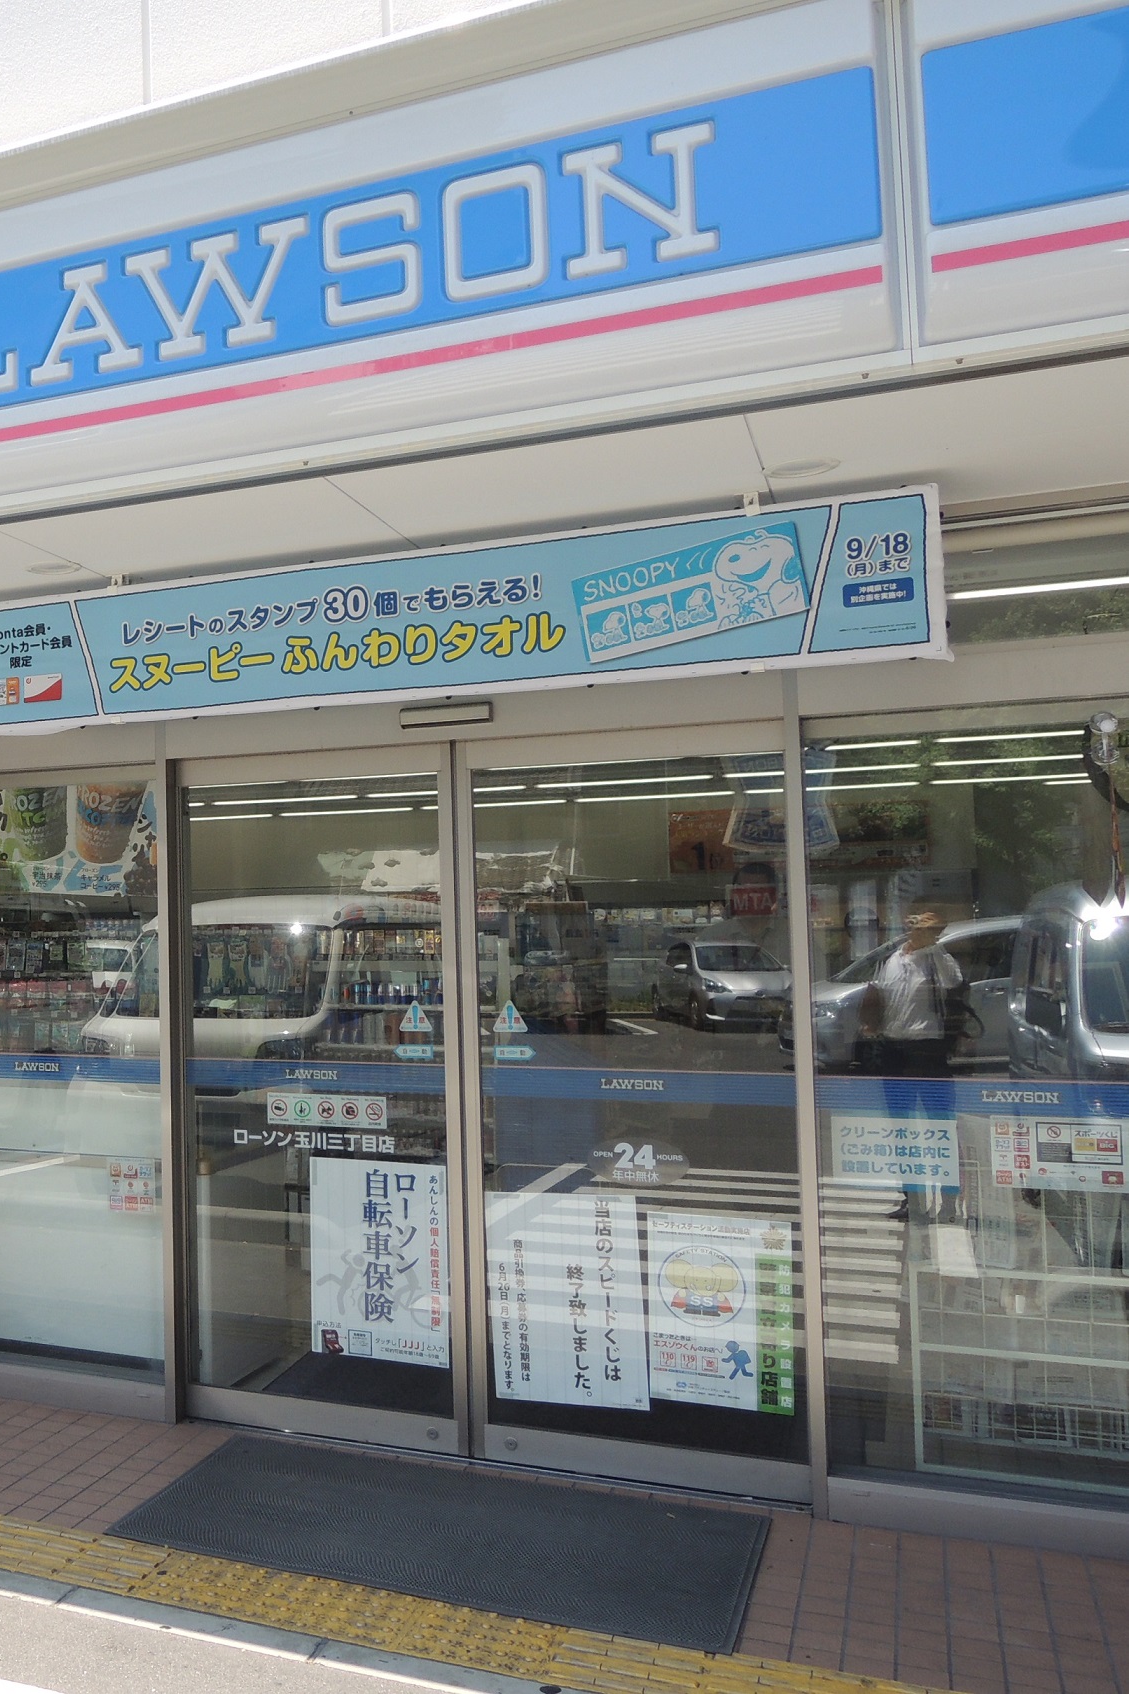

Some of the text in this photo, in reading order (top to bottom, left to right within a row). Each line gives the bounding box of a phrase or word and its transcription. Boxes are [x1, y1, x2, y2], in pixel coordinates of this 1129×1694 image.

[846, 532, 910, 560] 9/18
[846, 556, 910, 577] (月)まで
[583, 556, 681, 602] SNOOPY
[9, 655, 32, 668] 限定
[80, 873, 111, 882] キャラメル
[15, 1062, 60, 1072] LAWSON
[285, 1069, 338, 1080] LAWSON
[600, 1078, 665, 1091] LAWSON
[982, 1090, 1060, 1104] LAWSON
[840, 1126, 951, 1141] クリーンボックス
[1074, 1129, 1119, 1138] スポーツくじ
[233, 1129, 395, 1154] ローソン玉川三丁目店
[593, 1142, 684, 1170] OPEN 24 HOURS
[840, 1142, 951, 1158] (ごみ箱)は店内に
[612, 1169, 660, 1183] 年中無休
[841, 1160, 950, 1177] 設置しています。
[394, 1173, 420, 1275] ローソン
[362, 1168, 395, 1324] 自転車保険
[594, 1200, 622, 1382] 当店のスピードくじは
[316, 1319, 342, 1329] 申込方法
[566, 1264, 593, 1398] 終了致しました。
[778, 1264, 792, 1409] 防犯カメラ設置店
[661, 1352, 674, 1360] 110
[682, 1354, 695, 1362] 119
